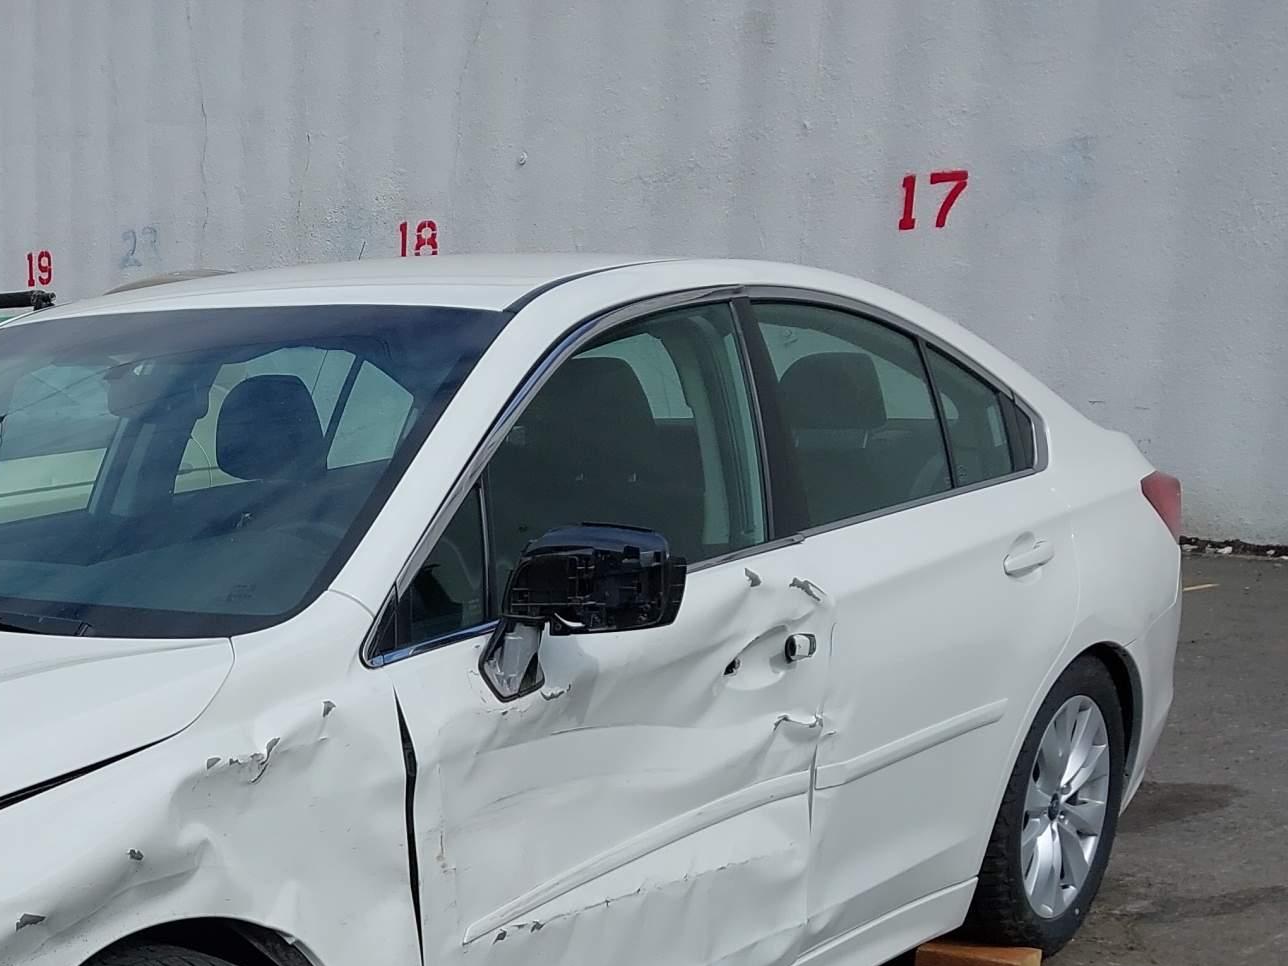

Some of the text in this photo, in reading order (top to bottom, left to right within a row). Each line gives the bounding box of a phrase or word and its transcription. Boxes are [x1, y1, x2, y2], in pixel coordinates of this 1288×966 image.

[897, 169, 969, 233] 17
[398, 219, 439, 257] 18
[26, 250, 54, 287] 19
